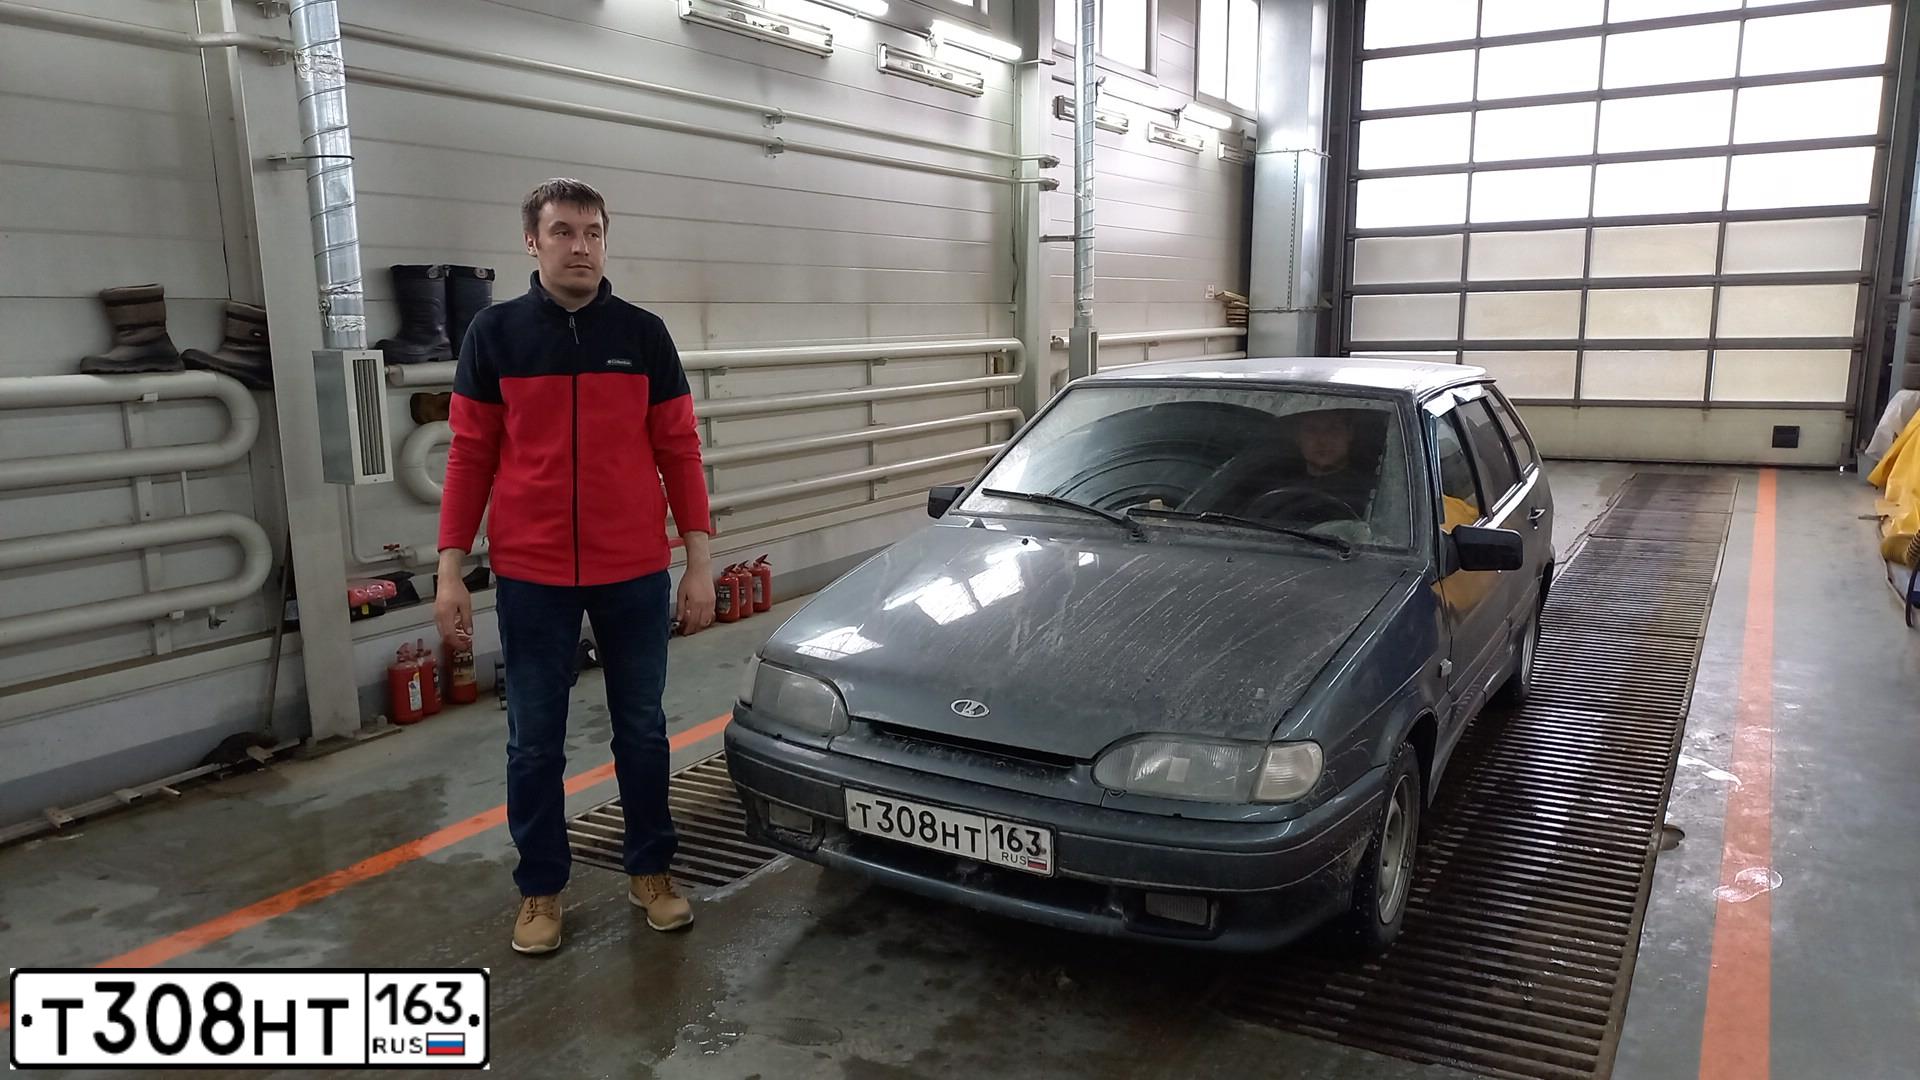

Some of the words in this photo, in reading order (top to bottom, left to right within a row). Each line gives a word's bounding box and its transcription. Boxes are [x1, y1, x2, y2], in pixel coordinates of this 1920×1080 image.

[856, 800, 982, 853] Т308НТ
[990, 824, 1041, 856] 163
[1001, 851, 1027, 866] RUS
